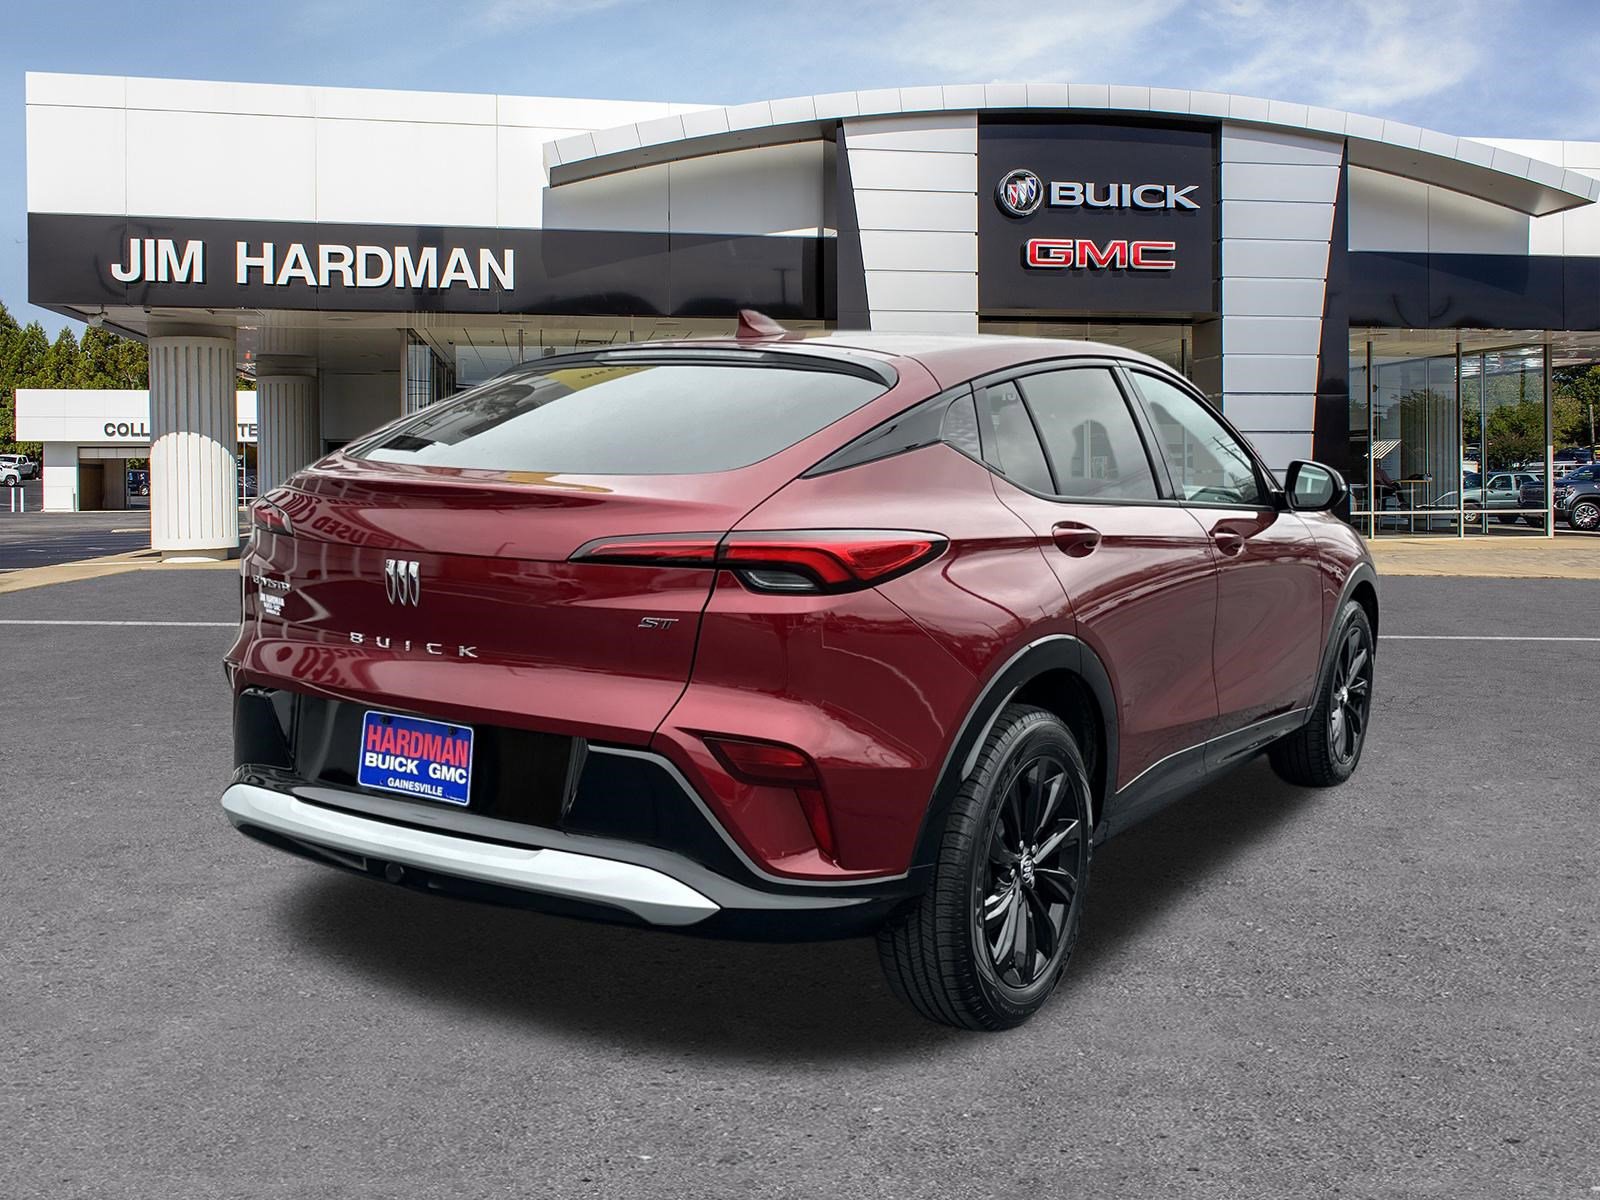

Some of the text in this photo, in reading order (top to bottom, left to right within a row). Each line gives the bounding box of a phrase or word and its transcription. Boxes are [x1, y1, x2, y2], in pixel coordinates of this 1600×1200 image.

[1050, 181, 1201, 209] BUICK
[110, 237, 515, 291] JIM HARDMAN
[1026, 237, 1177, 270] GMC
[637, 616, 680, 630] ST
[349, 631, 479, 659] BUICK
[366, 723, 469, 769] HARDMAN
[364, 751, 468, 785] BUICK GMC
[386, 777, 444, 797] GAINESVILLE
